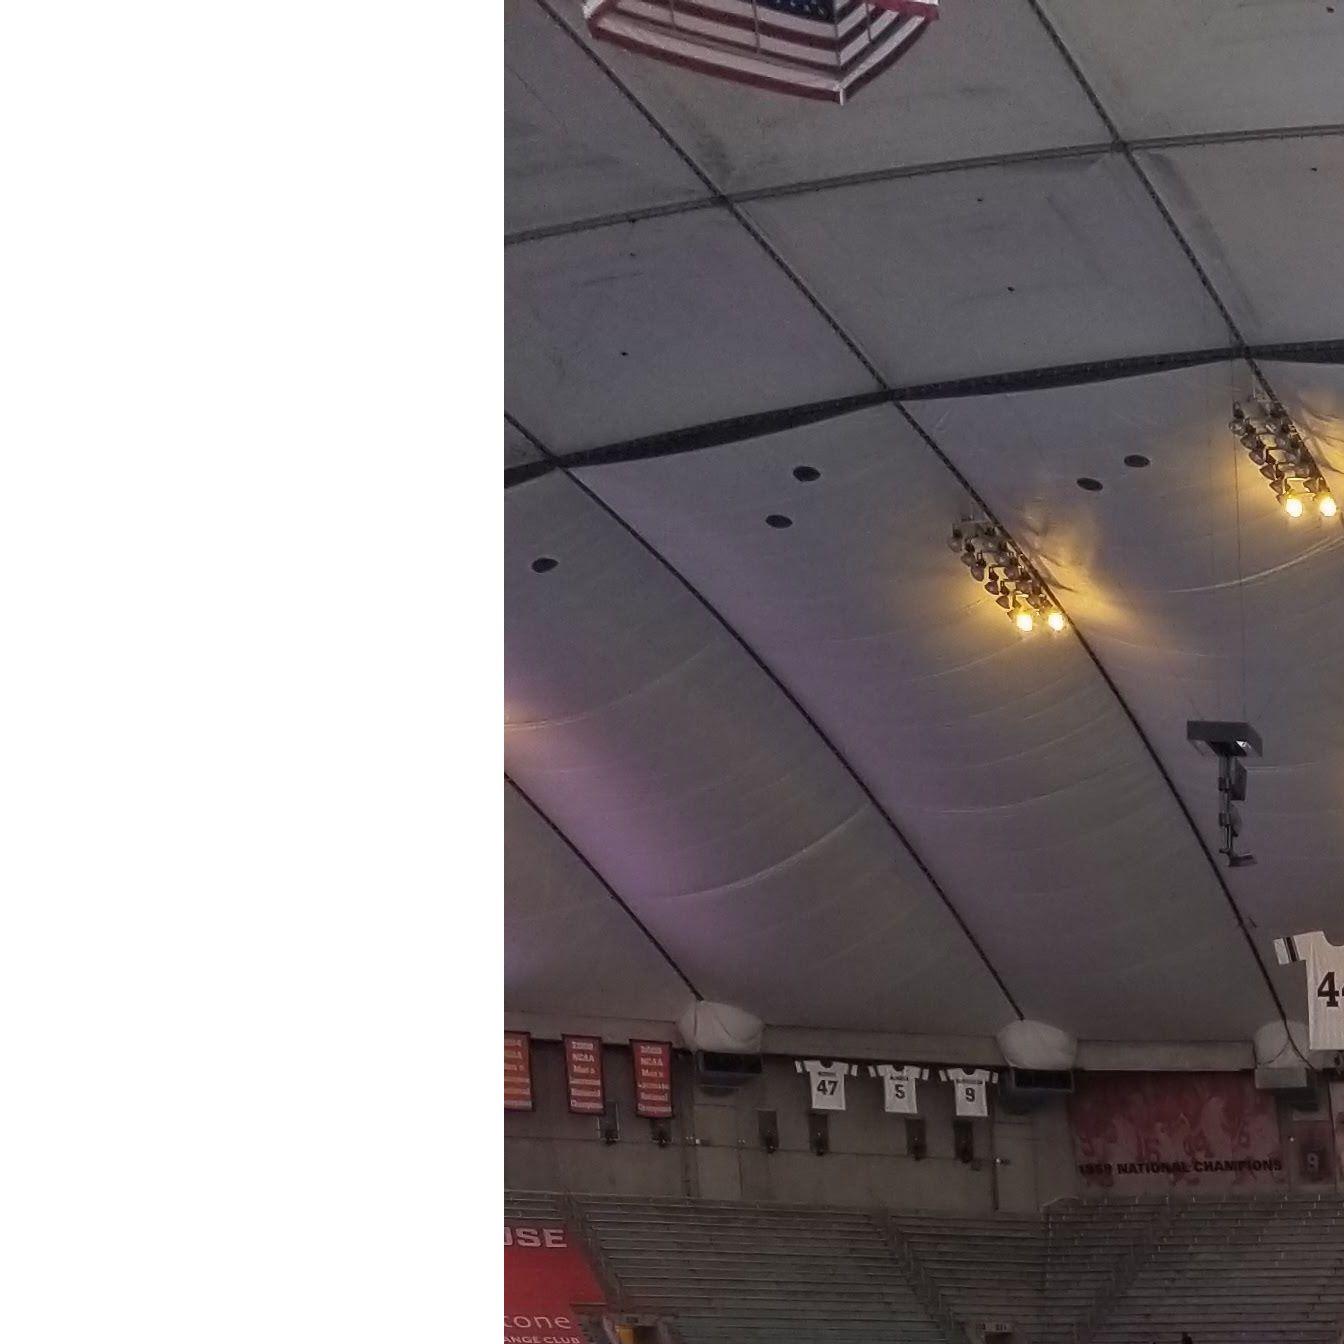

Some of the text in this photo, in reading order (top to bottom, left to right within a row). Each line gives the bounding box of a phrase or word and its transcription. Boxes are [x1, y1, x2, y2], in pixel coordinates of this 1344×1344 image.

[817, 1080, 838, 1096] 47
[894, 1084, 905, 1099] 5
[1117, 1160, 1192, 1175] NATIONAL
[1193, 1158, 1283, 1173] CHAMPIONS
